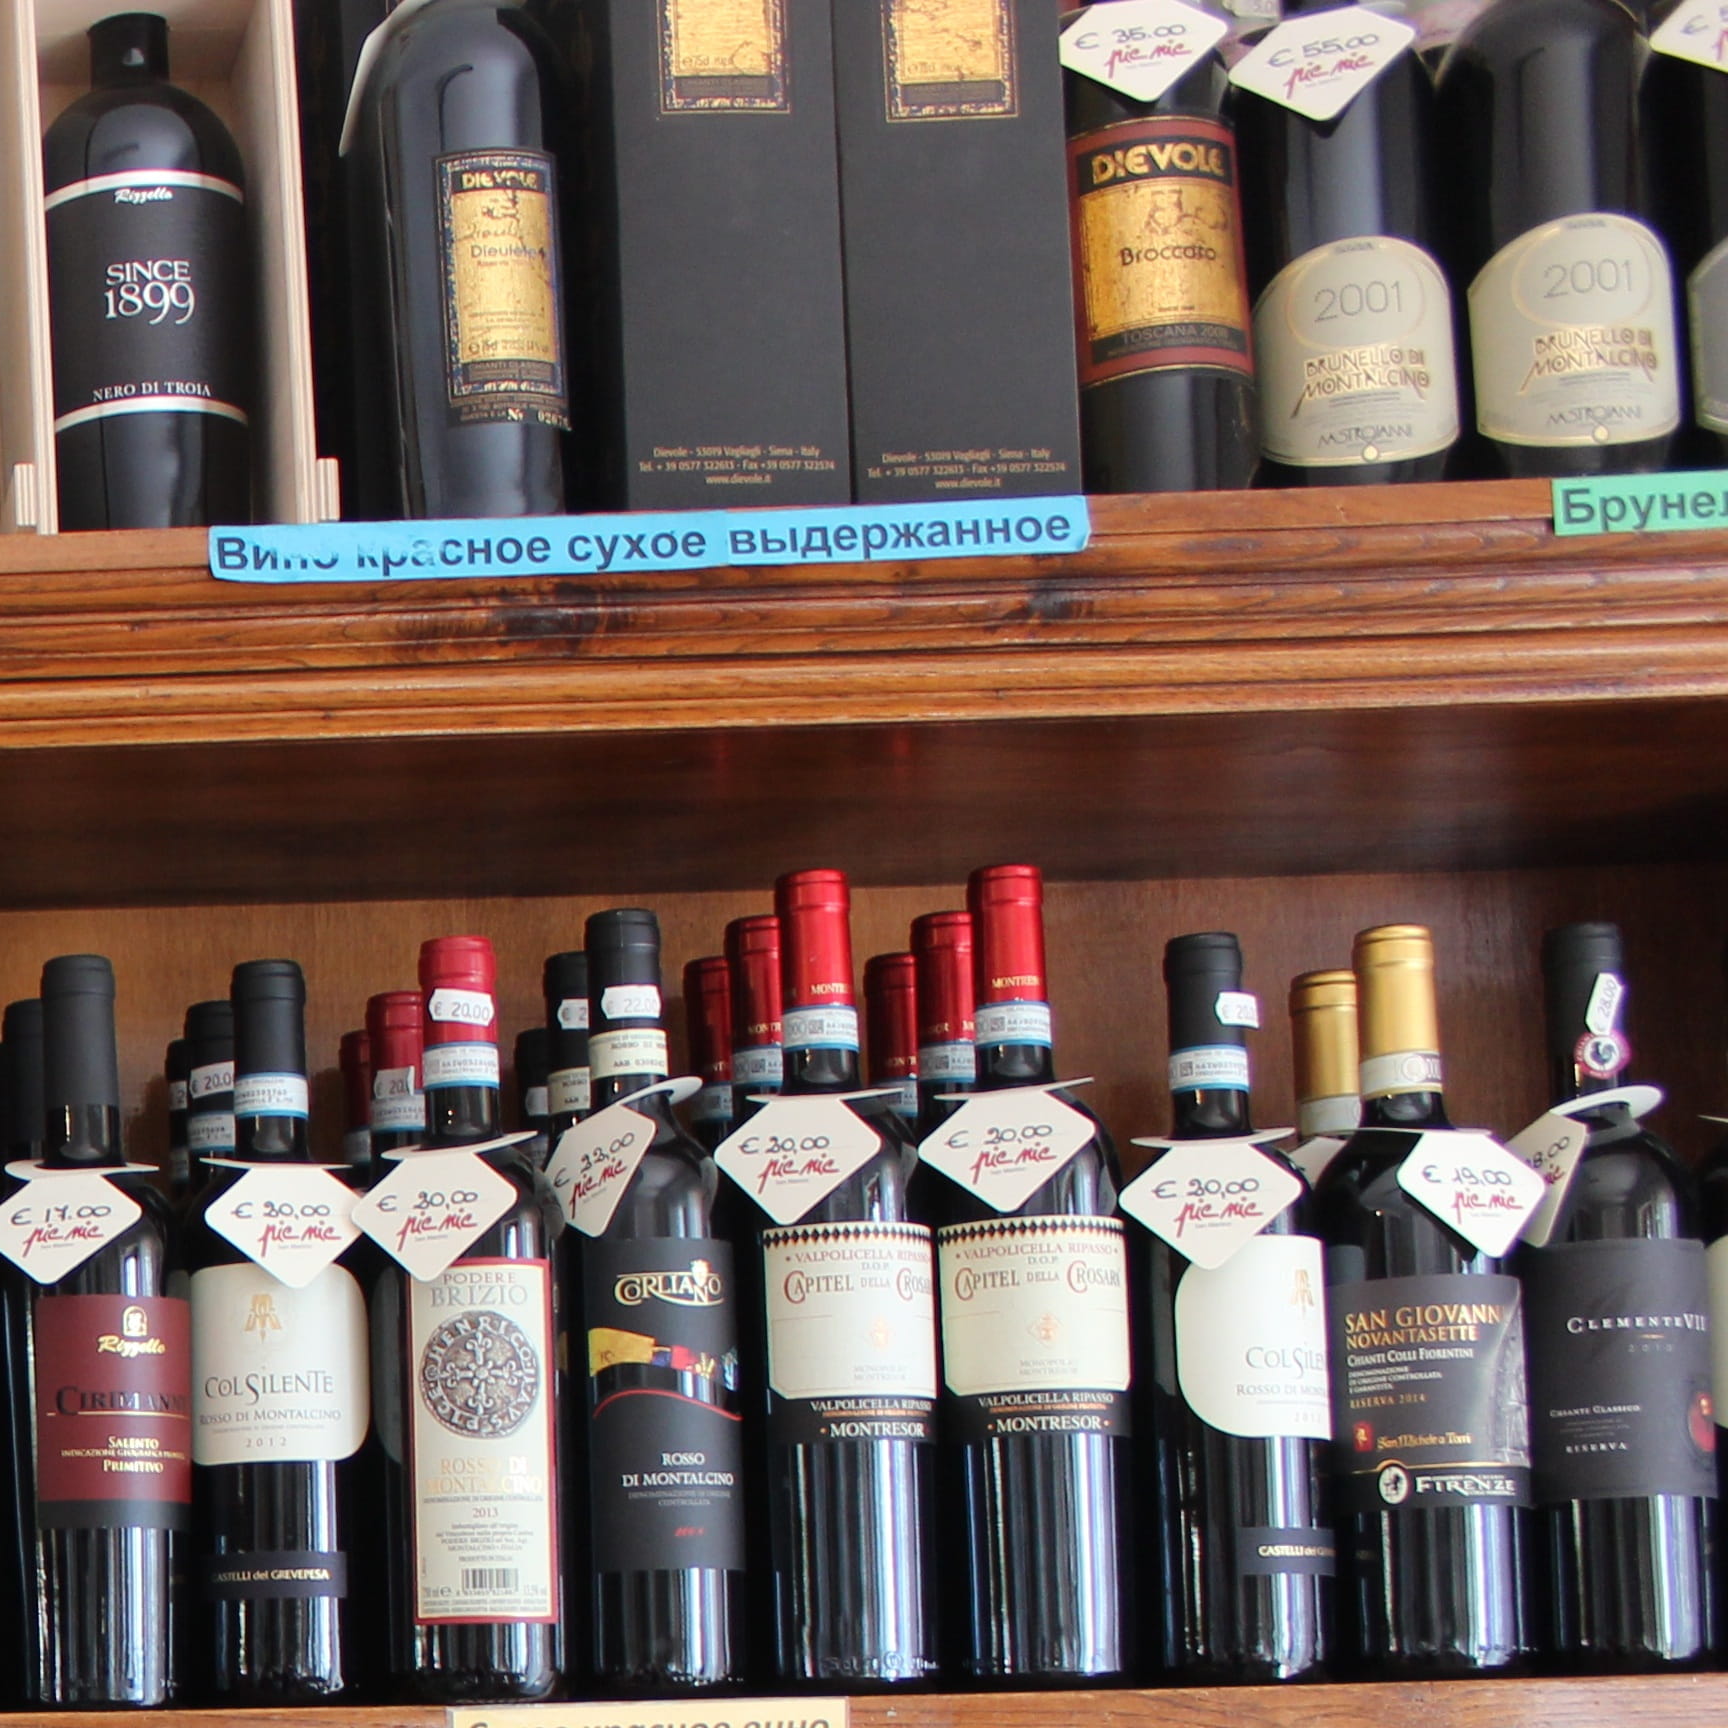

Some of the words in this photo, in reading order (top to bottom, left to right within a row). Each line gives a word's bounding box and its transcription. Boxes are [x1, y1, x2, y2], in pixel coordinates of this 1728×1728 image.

[1092, 142, 1225, 185] DIEVOLE
[106, 260, 192, 283] SINCE
[104, 282, 195, 324] 1899
[1313, 280, 1405, 323] 2001
[1304, 344, 1403, 378] BRUNELLO
[1407, 348, 1423, 365] DI
[92, 382, 136, 401] NERO
[142, 382, 159, 396] DI
[163, 381, 212, 398] TROIA
[567, 531, 707, 571] сухое
[729, 506, 1068, 563] выдержанное
[441, 1269, 517, 1286] PODERE
[429, 1284, 530, 1307] BRIZIO
[1344, 1310, 1389, 1334] SAN
[1566, 1315, 1682, 1334] CLEMENTE
[1346, 1325, 1478, 1349] NOVANTASETTE
[996, 1415, 1102, 1433] MONTRESOR
[662, 1452, 705, 1466] ROSSO
[622, 1473, 640, 1486] DI
[642, 1471, 735, 1486] MONTALCINO
[1414, 1474, 1516, 1496] FIRENZE
